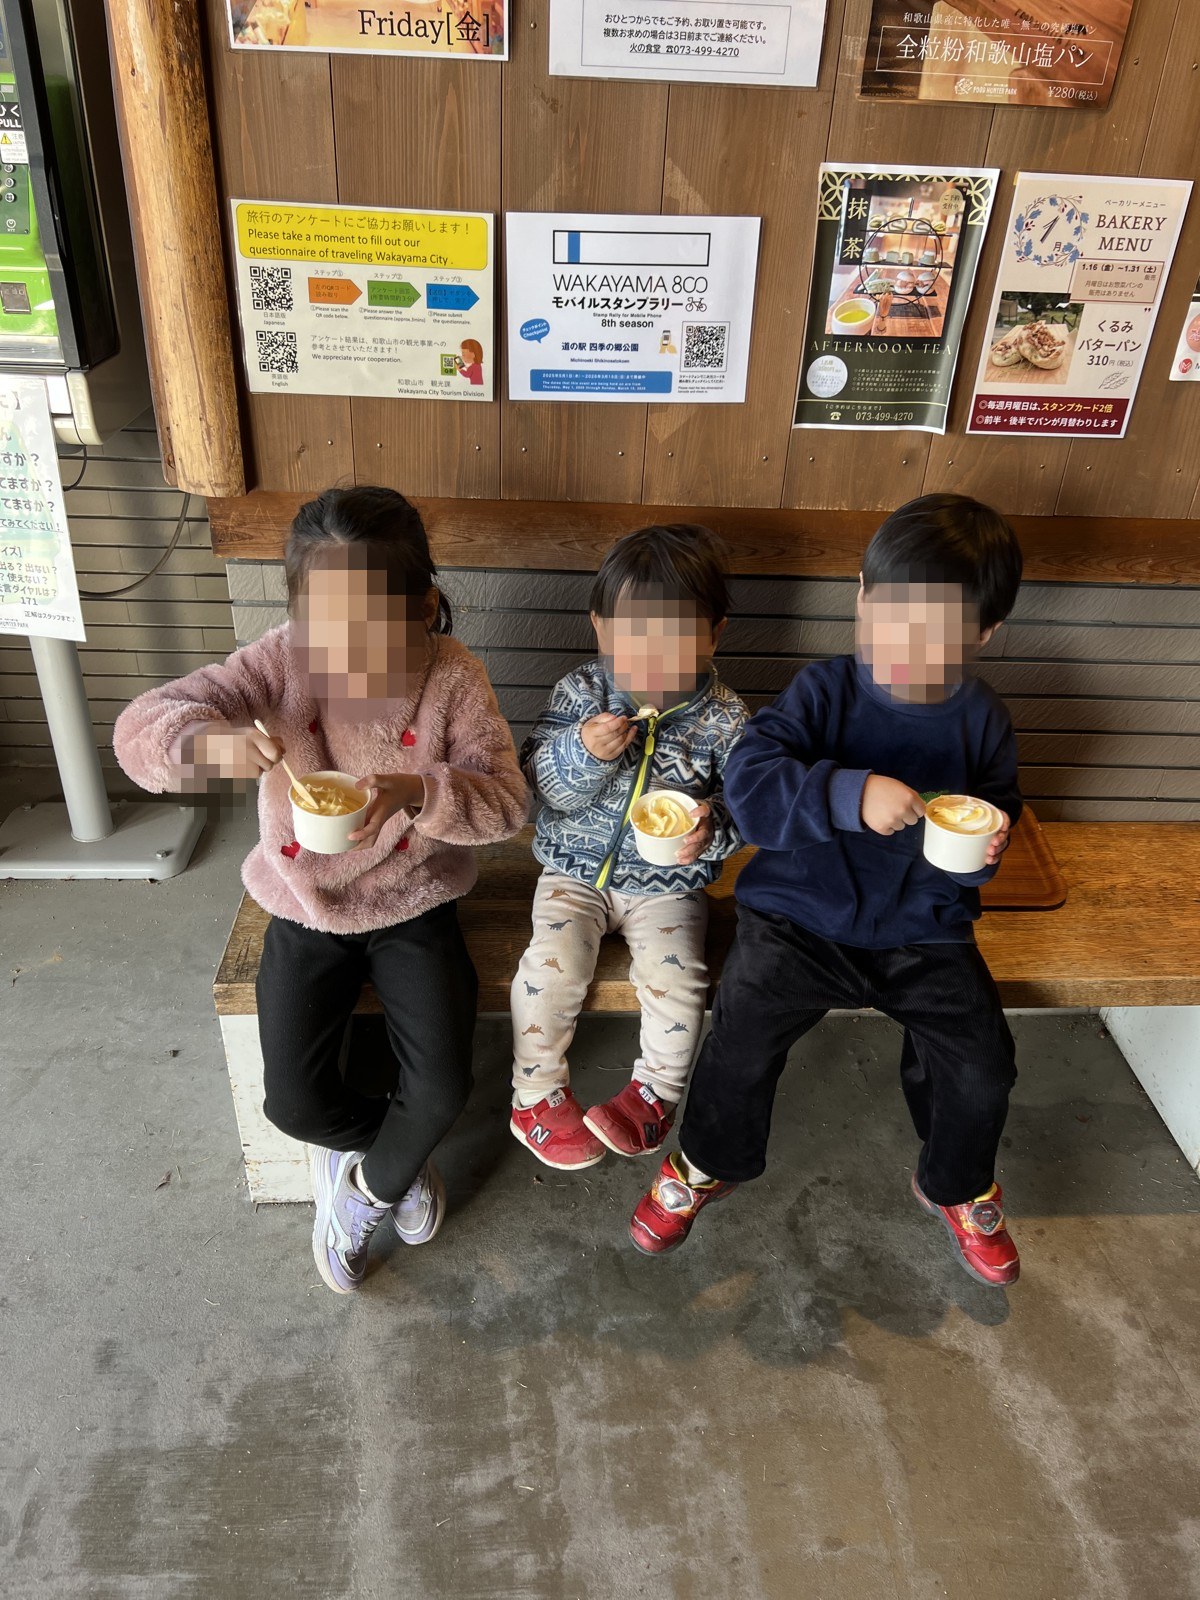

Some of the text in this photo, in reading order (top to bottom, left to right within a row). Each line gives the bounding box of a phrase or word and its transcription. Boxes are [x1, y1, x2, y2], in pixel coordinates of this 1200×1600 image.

[605, 13, 767, 31] おひとつからでもご予約、お取り置き可能です。
[629, 43, 661, 54] 火の食堂
[896, 33, 1094, 69] 全粒粉和歌山塩パン
[1104, 199, 1167, 209] ベーカリーメニュー
[246, 209, 470, 235] 旅行のアンケートにご協力お願いします！
[842, 197, 869, 259] 抹茶
[1095, 214, 1168, 231] BAKERY
[248, 229, 280, 241] Please
[282, 231, 303, 242] take
[314, 233, 355, 245] moment
[358, 236, 367, 245] to
[370, 234, 382, 246] fill
[385, 237, 401, 247] out
[404, 239, 421, 248] our
[1098, 236, 1153, 252] MENU
[1053, 241, 1062, 252] 月
[249, 245, 448, 267] questionnaire of traveling Wakayama City
[552, 273, 668, 294] WAKAYAMA
[1084, 280, 1144, 289] 月曜日はお惣菜パンの
[1088, 289, 1135, 298] 販売はありません
[552, 296, 683, 311] モバイルスタンプラリー
[601, 318, 654, 328] 8th season
[1097, 320, 1133, 334] くるみ
[562, 342, 639, 352] 道の駅 四季の郷公園
[810, 340, 952, 355] AFTERNOON TEA
[1078, 338, 1142, 353] バターパン
[322, 354, 352, 362] appreciate
[368, 356, 402, 364] cooperation.
[397, 378, 451, 388] 和歌山市 観光課
[428, 389, 439, 397] City
[855, 411, 914, 421] 073-499-4270
[0, 498, 55, 513] てますか？
[21, 596, 39, 606] 171
[551, 1096, 564, 1107] 313
[529, 1124, 551, 1145] N
[643, 1123, 658, 1143] N
